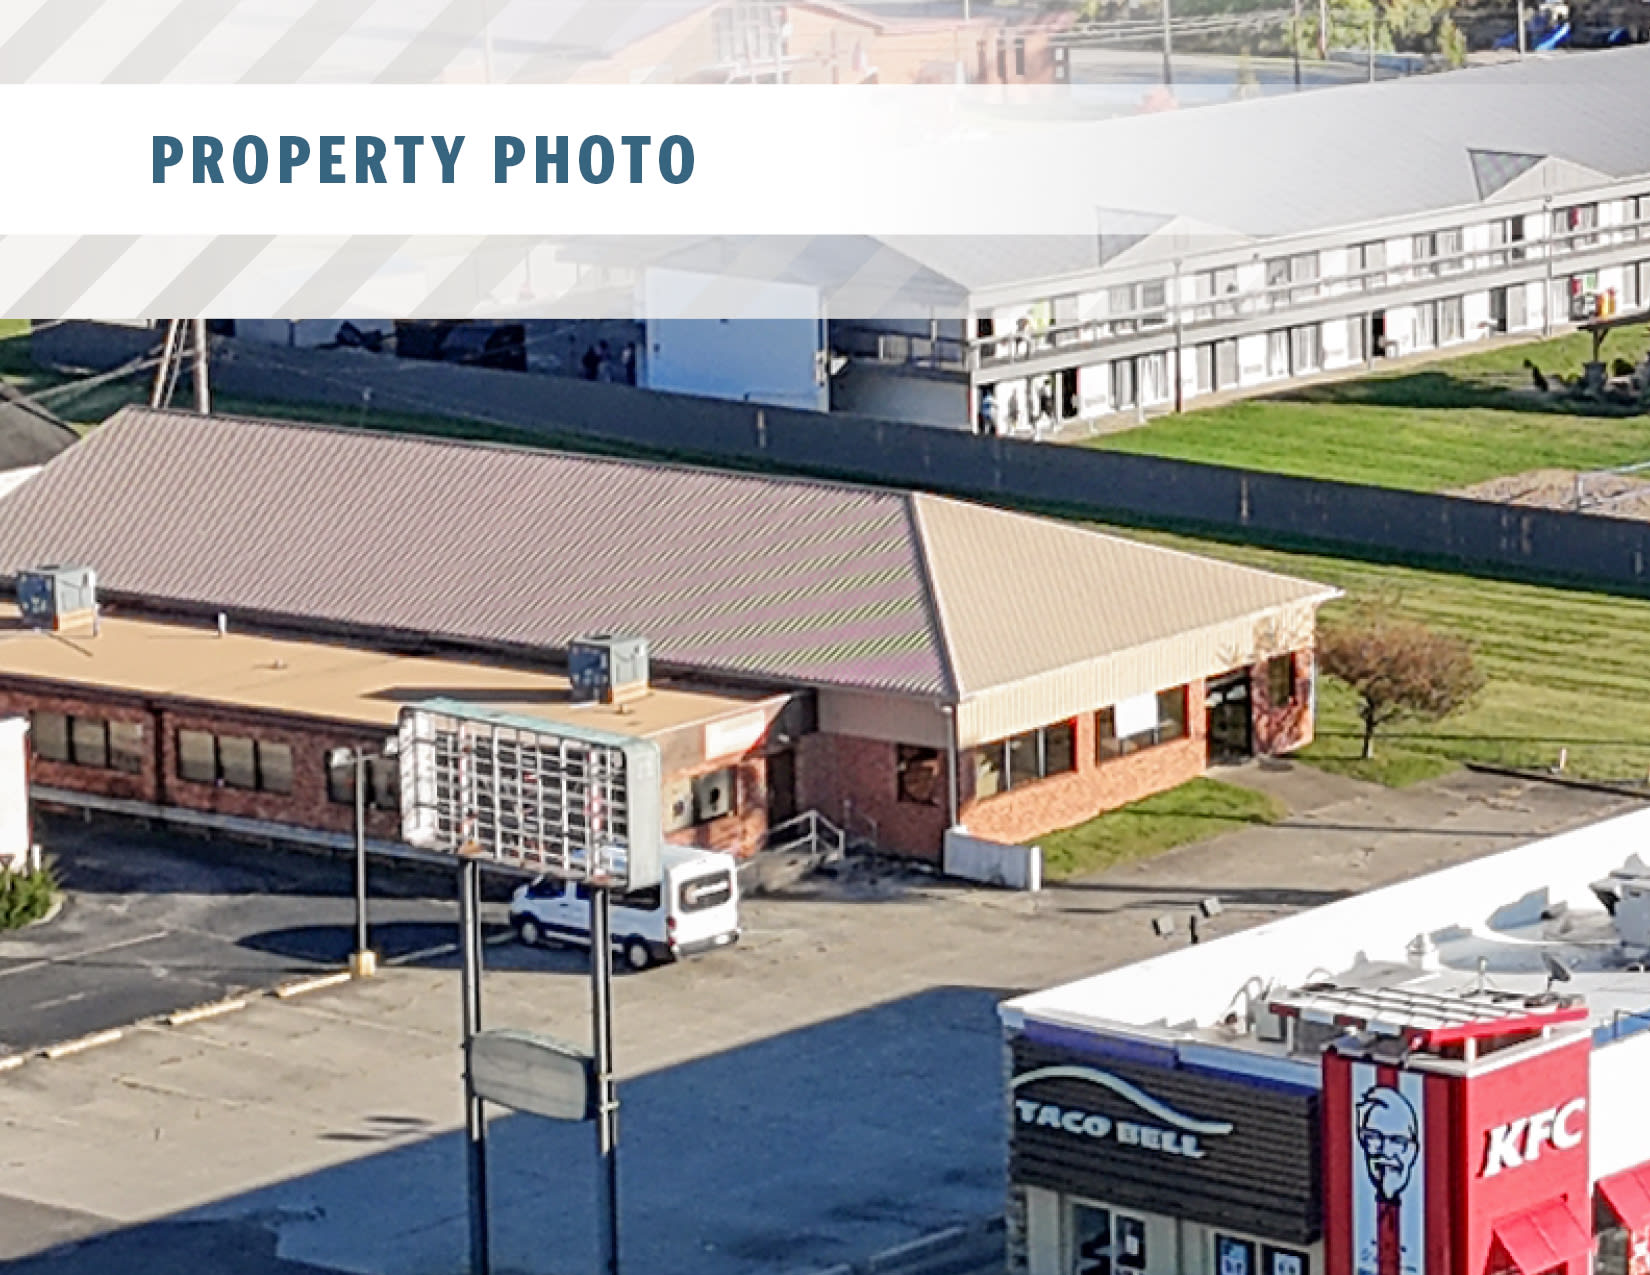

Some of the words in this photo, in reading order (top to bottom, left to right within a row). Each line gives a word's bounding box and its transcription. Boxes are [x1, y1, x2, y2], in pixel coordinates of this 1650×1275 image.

[1014, 1099, 1112, 1138] TACO
[1115, 1119, 1208, 1159] BELL
[1477, 1096, 1586, 1178] KFC
